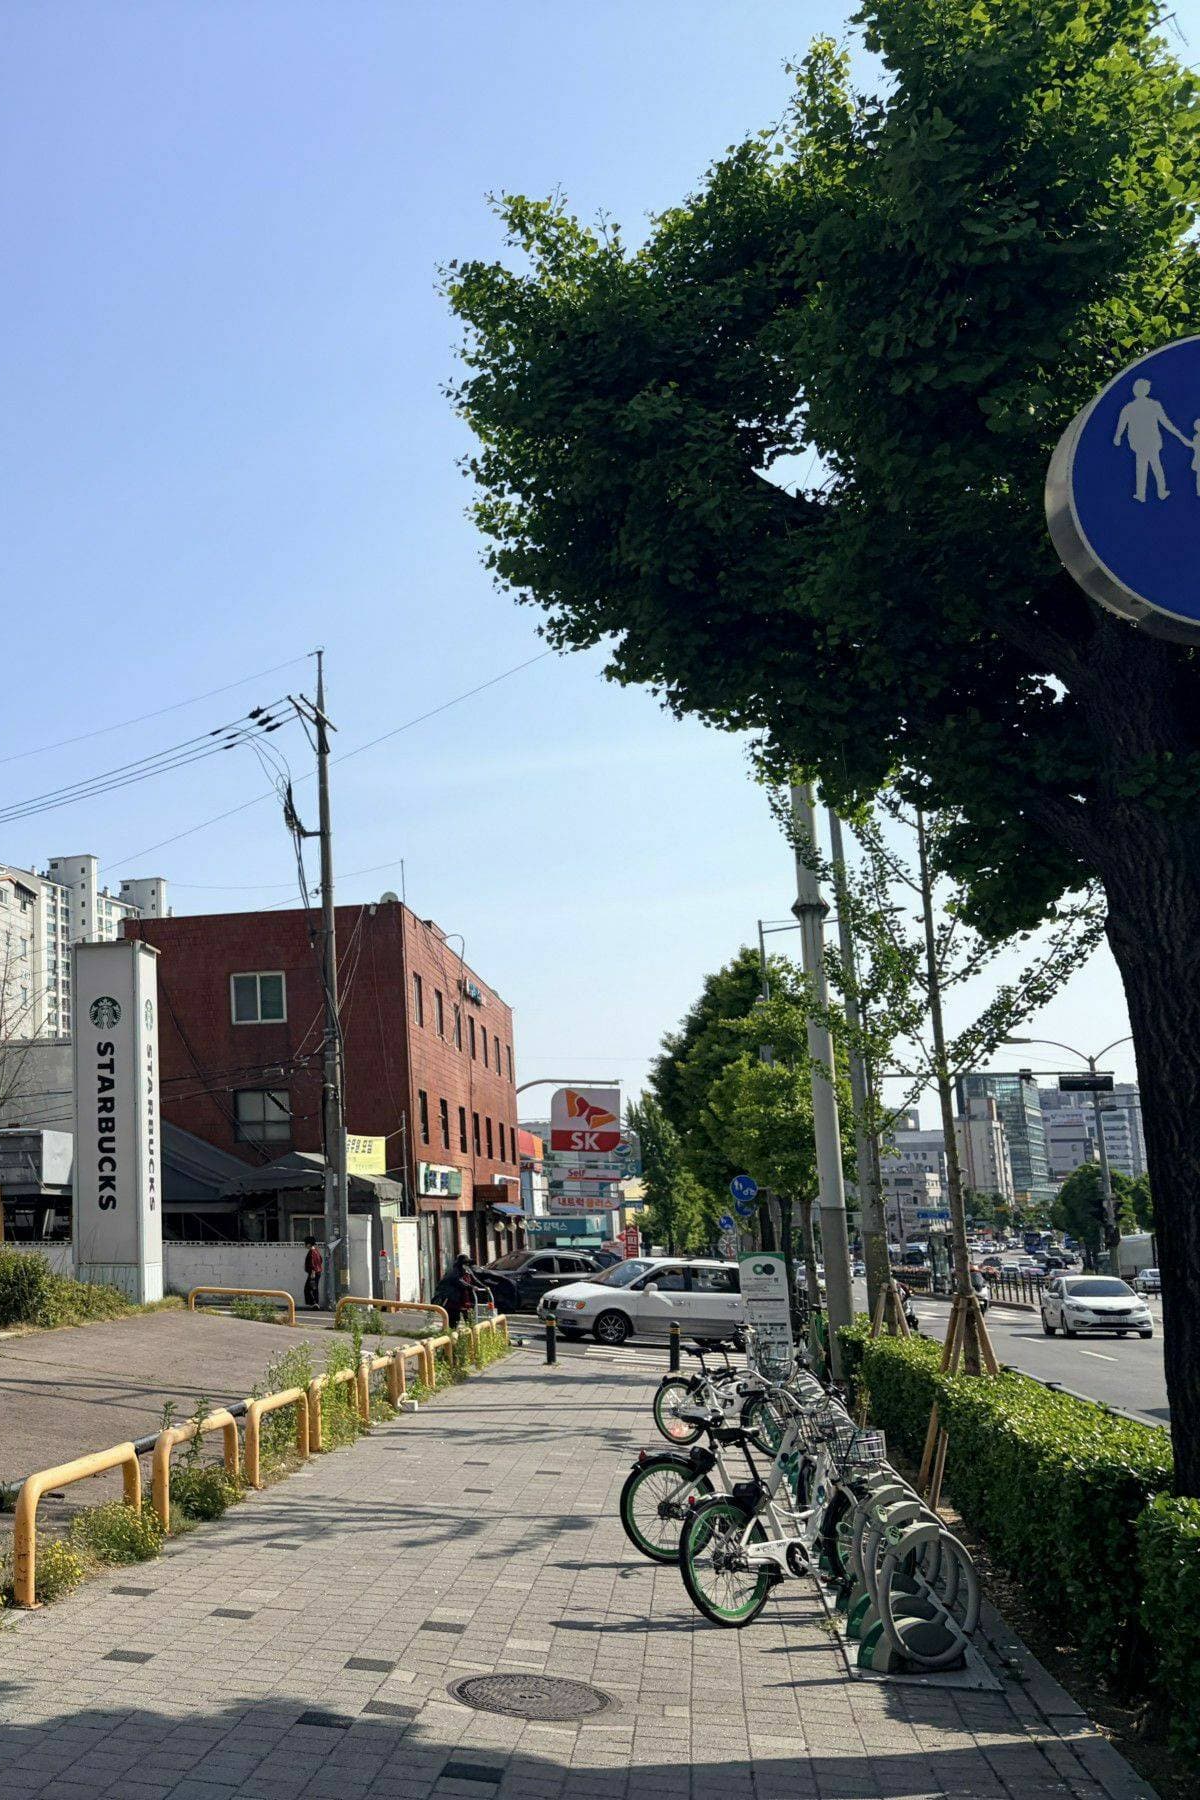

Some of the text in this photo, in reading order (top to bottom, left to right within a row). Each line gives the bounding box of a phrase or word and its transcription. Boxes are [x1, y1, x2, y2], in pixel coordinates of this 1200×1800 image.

[97, 1041, 116, 1212] STARBUCKS
[145, 1043, 157, 1212] STARBUCKS
[567, 1168, 586, 1178] Self
[570, 1131, 600, 1151] SK
